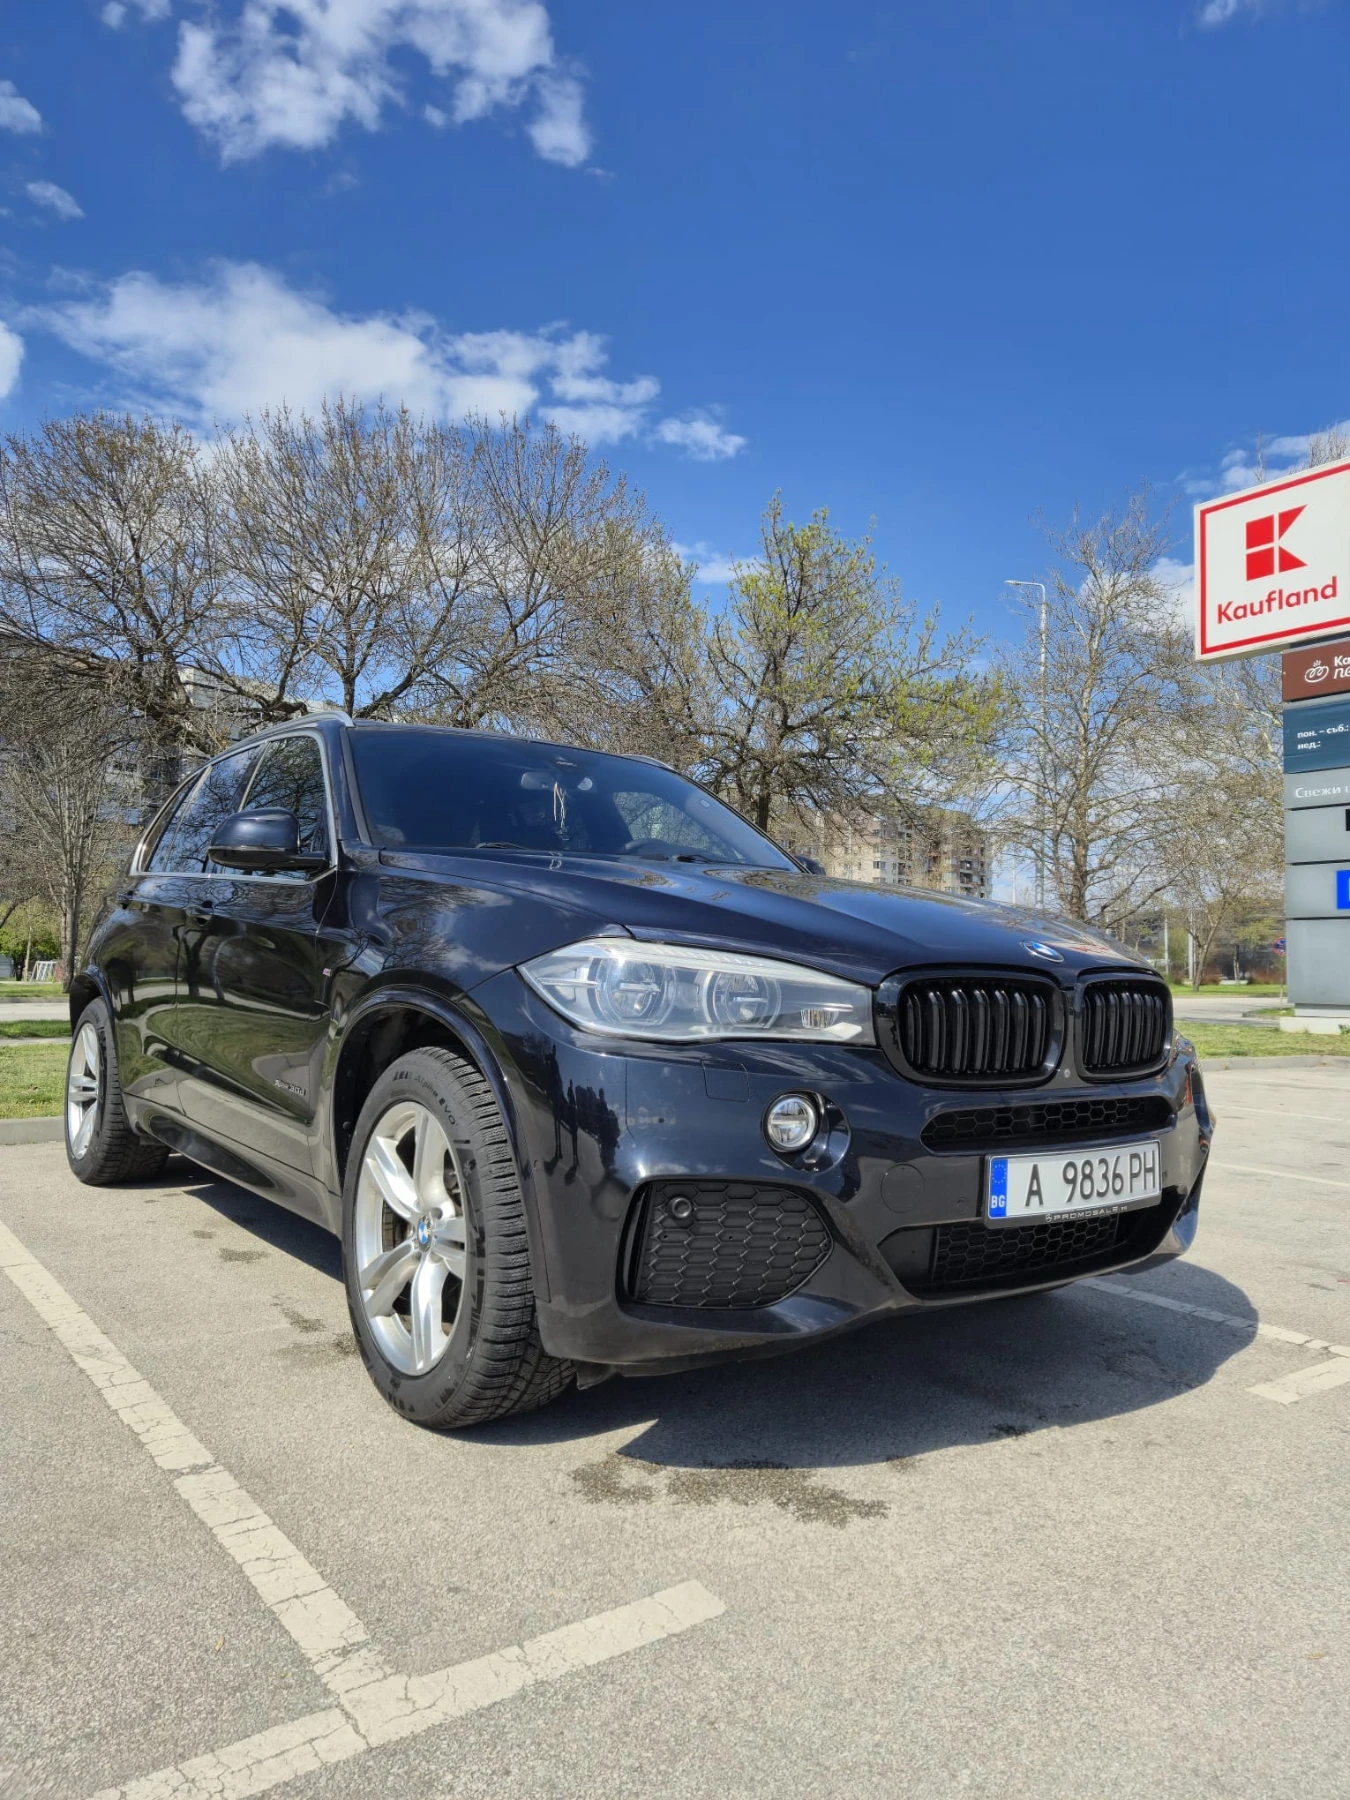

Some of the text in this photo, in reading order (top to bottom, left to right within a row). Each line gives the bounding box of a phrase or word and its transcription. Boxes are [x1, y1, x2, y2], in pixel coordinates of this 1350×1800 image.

[1217, 575, 1338, 625] Kaufland
[1297, 730, 1317, 739] пон.
[1295, 785, 1341, 798] Свежи
[1025, 1163, 1044, 1208] A
[991, 1195, 1006, 1210] BG
